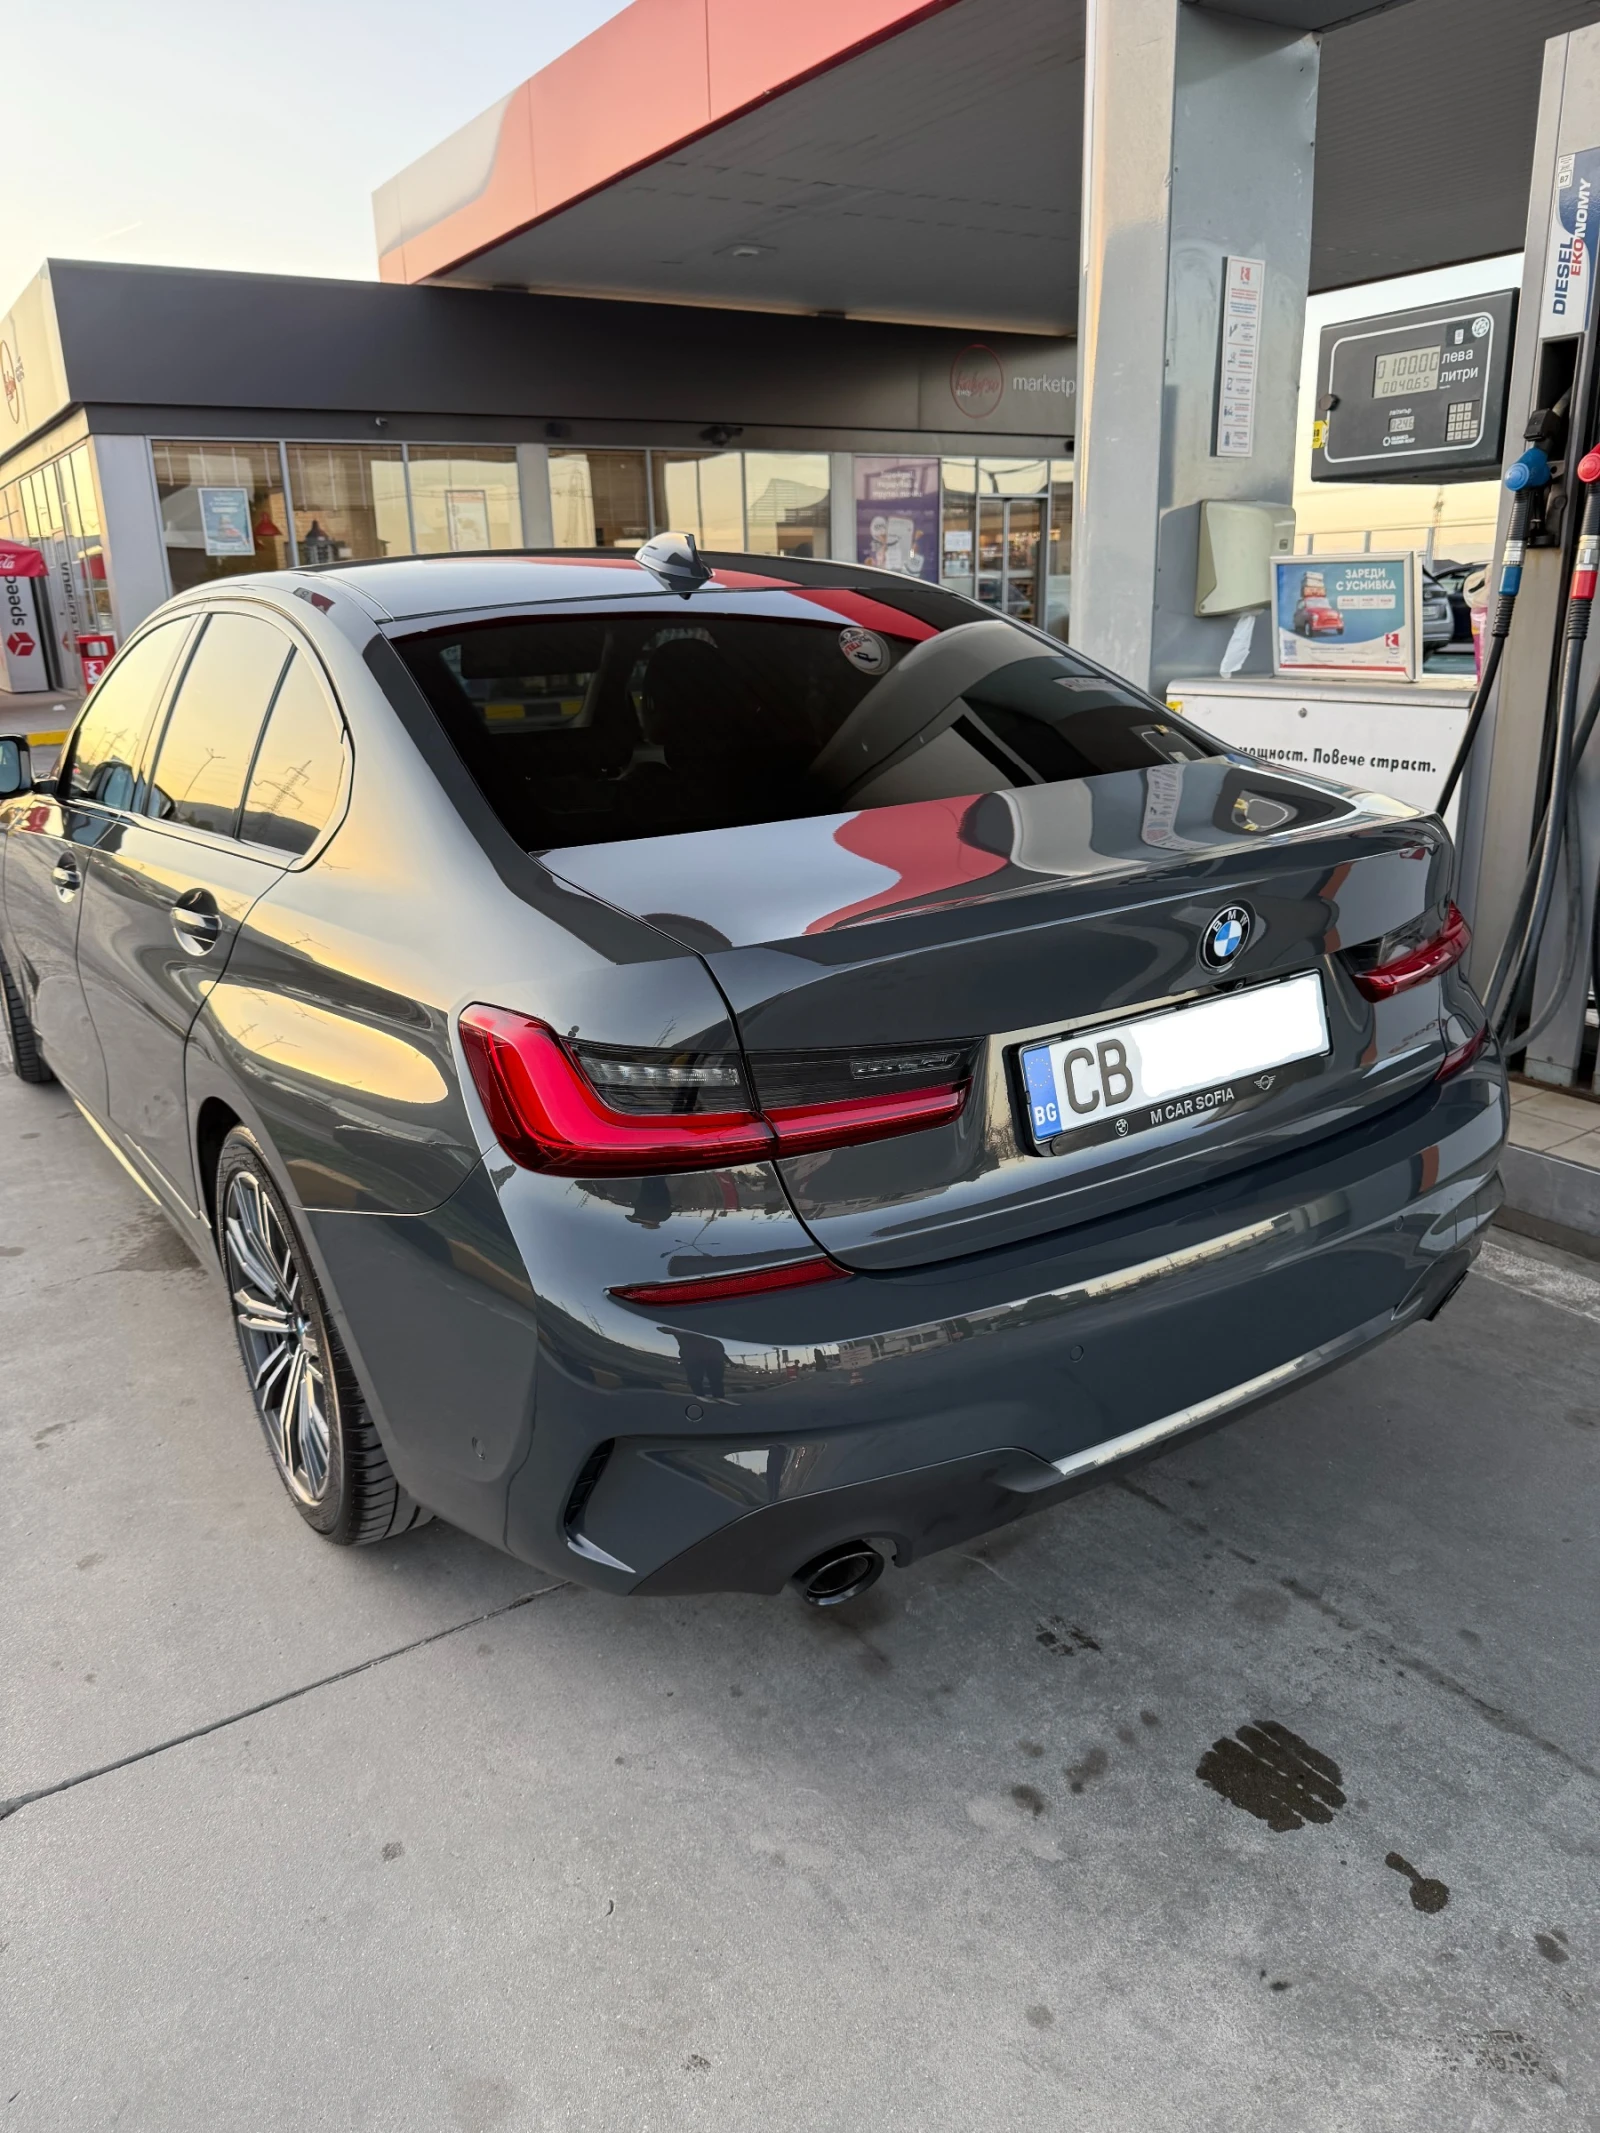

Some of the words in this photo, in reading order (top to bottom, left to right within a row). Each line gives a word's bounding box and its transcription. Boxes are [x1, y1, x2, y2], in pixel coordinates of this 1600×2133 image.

[1570, 178, 1592, 276] EKONOMY
[1553, 236, 1574, 315] DIESEL
[1441, 349, 1474, 365] лева
[1439, 366, 1479, 384] литри
[1336, 581, 1344, 591] С
[1345, 579, 1397, 591] УСМИВКА
[1345, 568, 1386, 579] ЗАРЕДИ
[1239, 746, 1308, 762] ощност.
[1312, 747, 1365, 767] Повече
[1369, 756, 1437, 773] страст.
[1212, 909, 1249, 933] BMW
[1063, 1038, 1134, 1115] CB
[1033, 1102, 1057, 1126] BG
[1150, 1108, 1164, 1125] M
[1164, 1099, 1194, 1121] CAR
[1195, 1087, 1236, 1111] SOFIA
